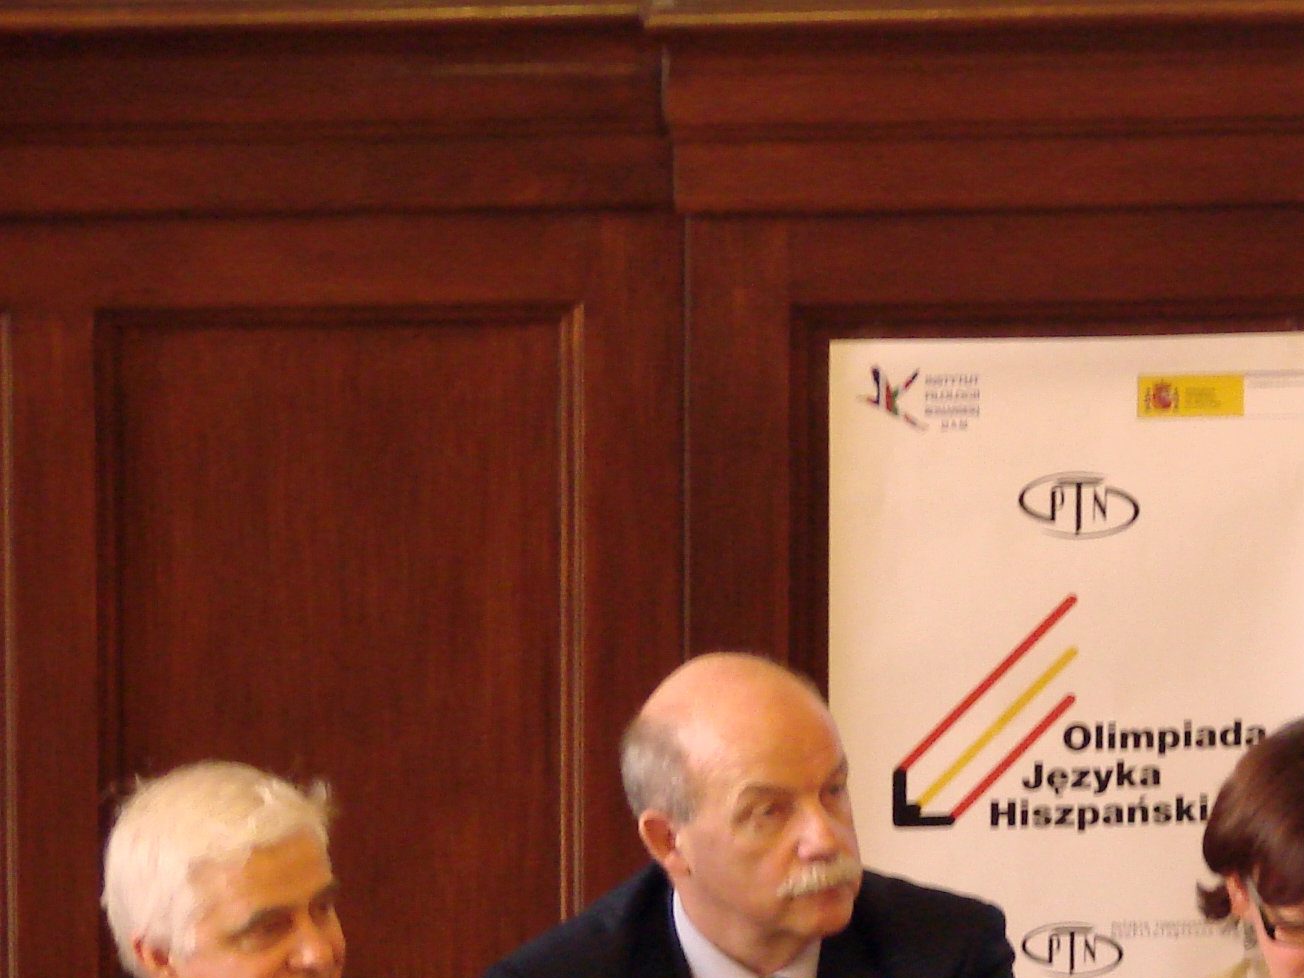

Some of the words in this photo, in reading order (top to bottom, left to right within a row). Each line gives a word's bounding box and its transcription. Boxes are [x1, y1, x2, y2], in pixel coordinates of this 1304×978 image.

[1063, 718, 1266, 755] Olimpiada
[1022, 759, 1161, 796] Języka
[989, 793, 1208, 833] Hiszpański
